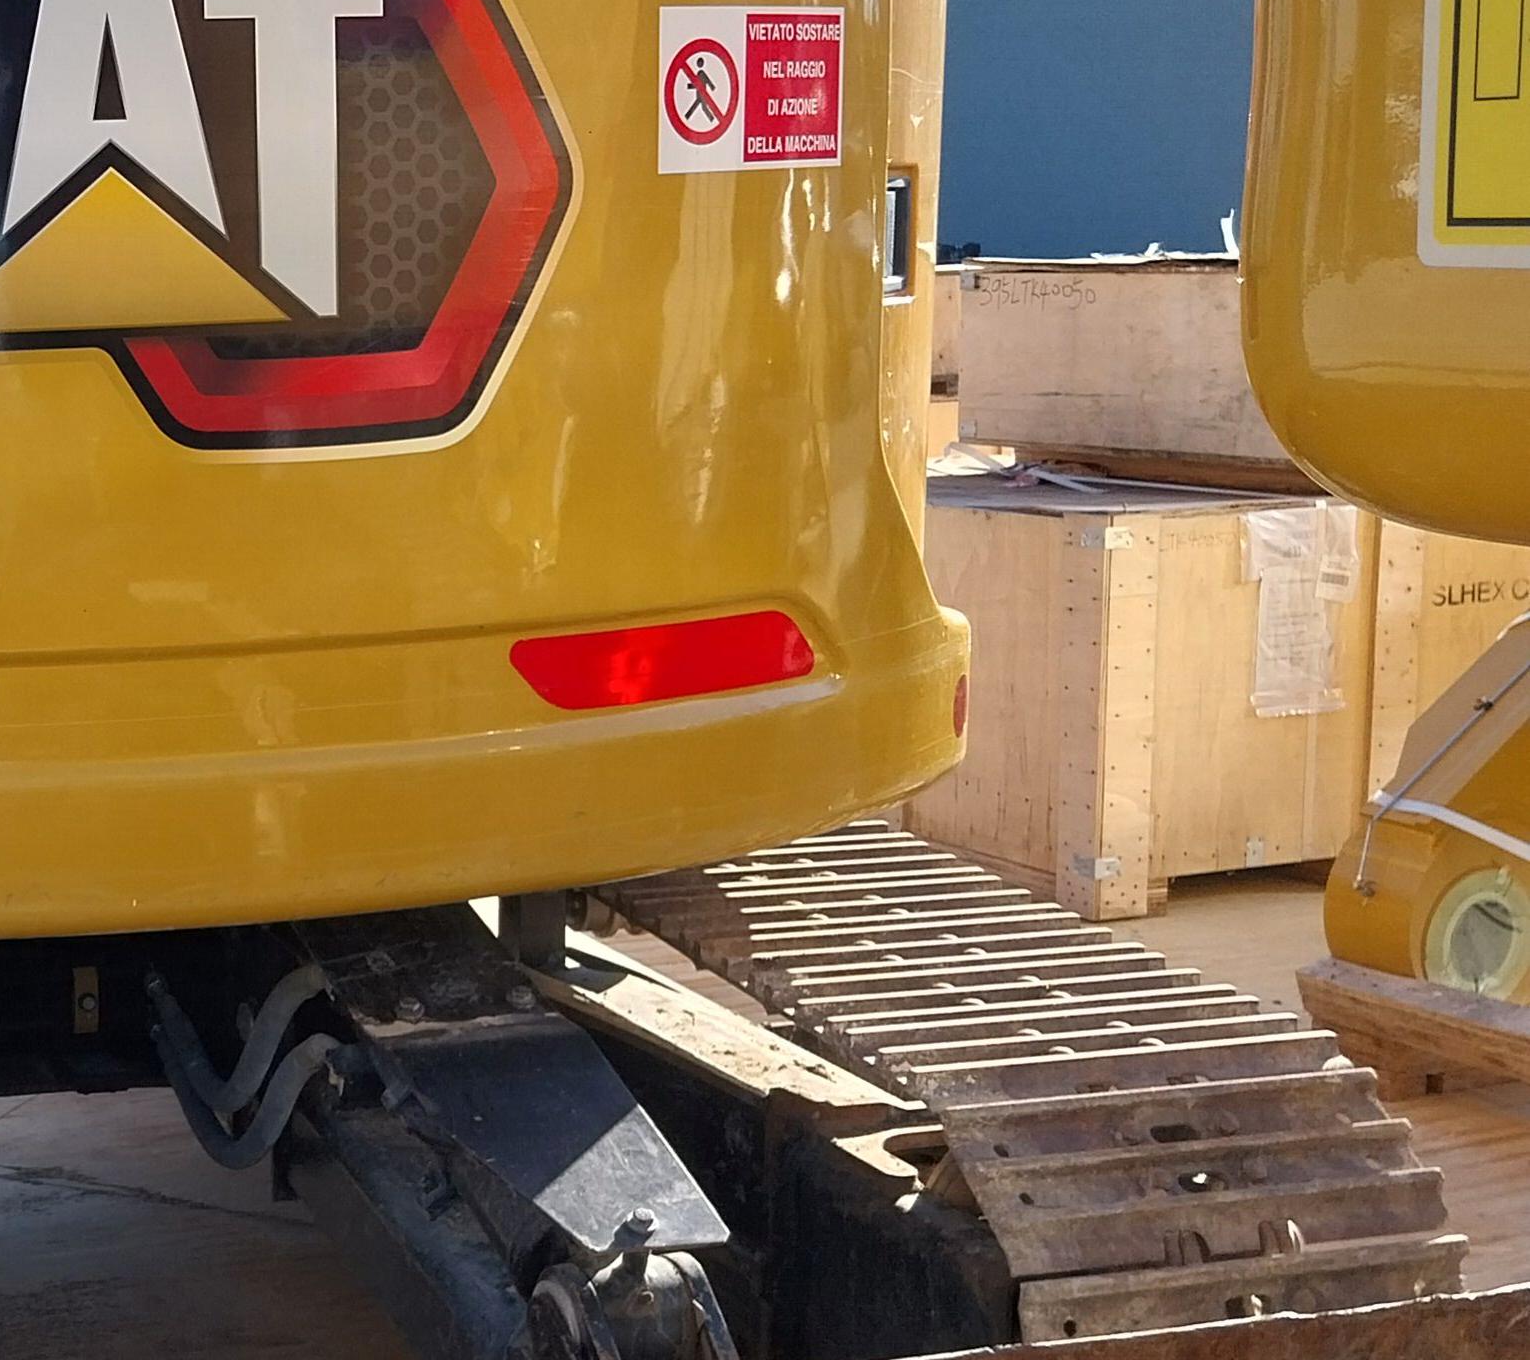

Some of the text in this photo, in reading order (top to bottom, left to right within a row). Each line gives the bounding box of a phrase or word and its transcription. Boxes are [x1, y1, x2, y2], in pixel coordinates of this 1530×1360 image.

[749, 23, 841, 41] VIETATO SOSTARE
[763, 60, 826, 78] NEL RAGGIO
[767, 98, 818, 116] DI AZIONE
[747, 134, 837, 154] DELLA MACCHINA
[1431, 580, 1506, 608] SLHEX
